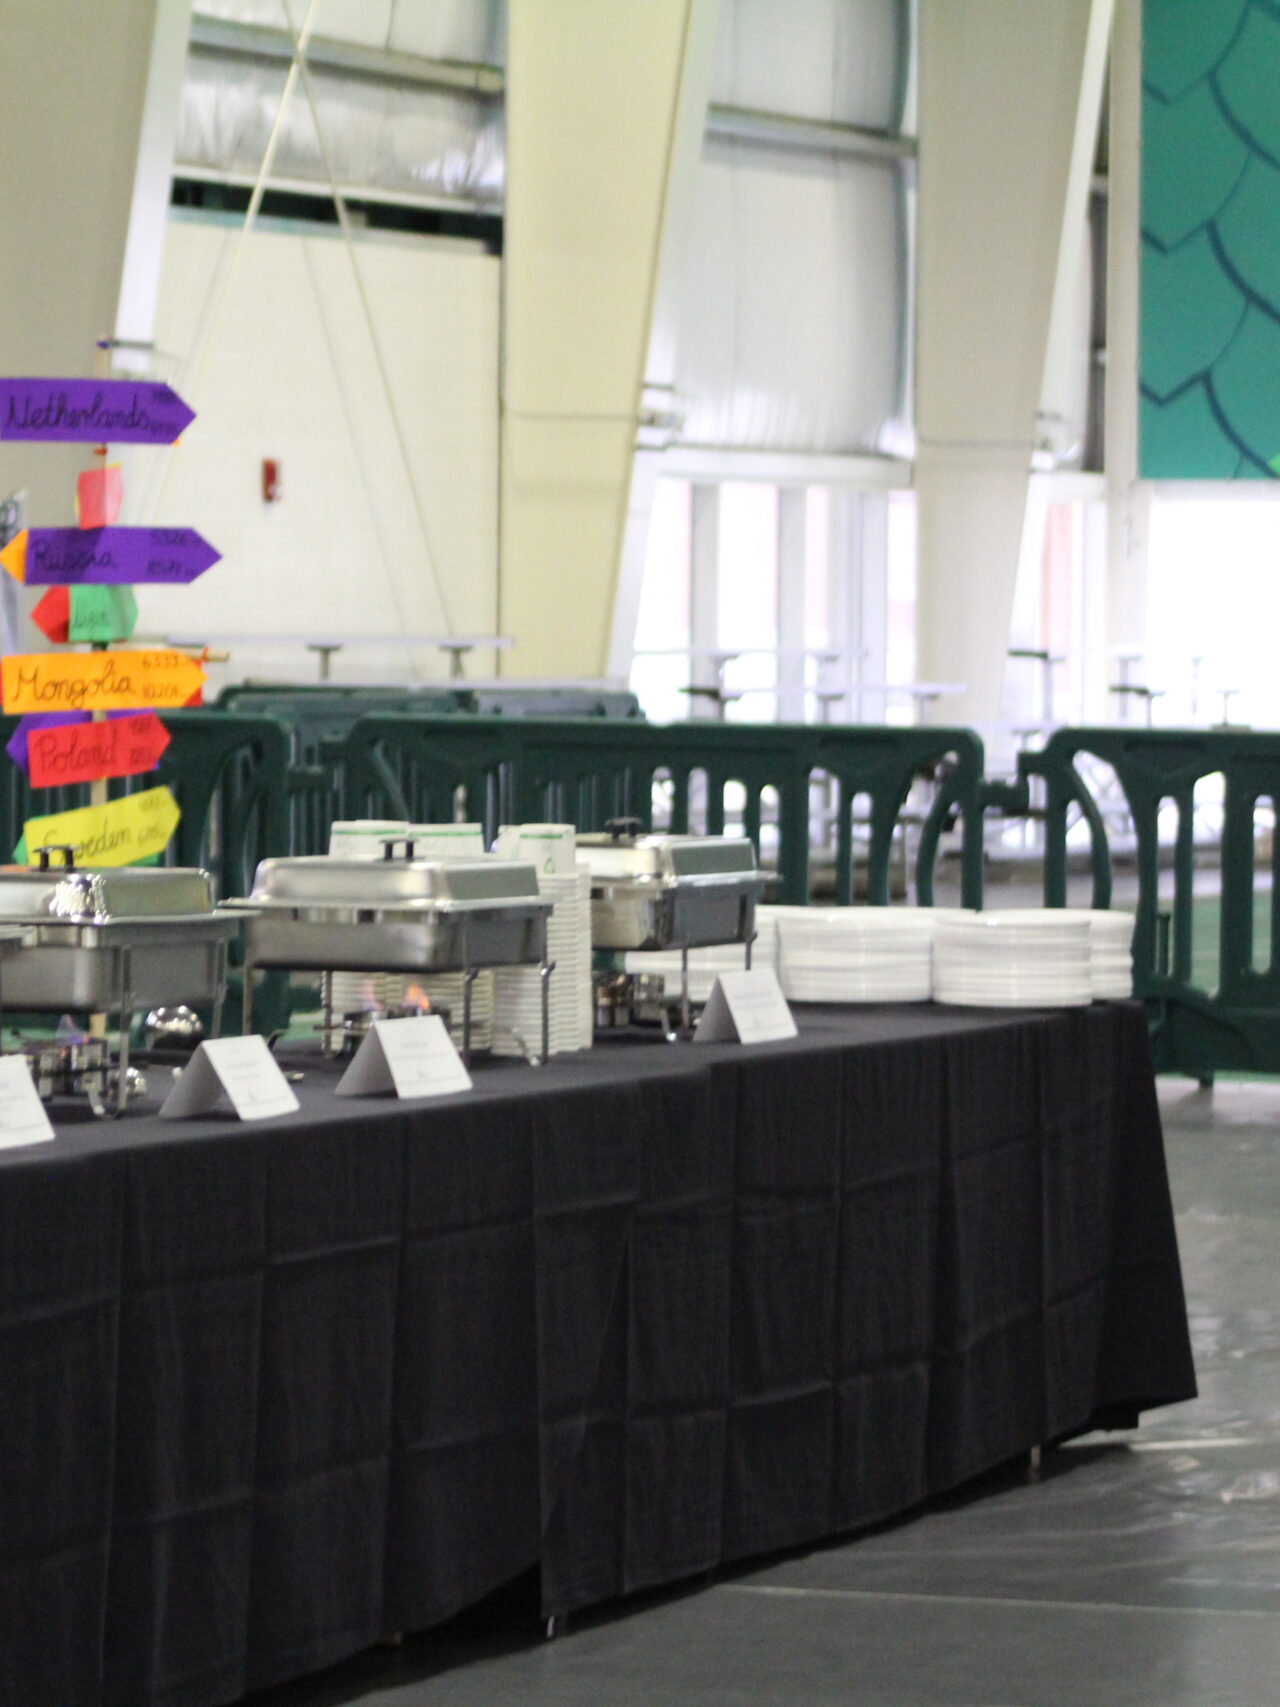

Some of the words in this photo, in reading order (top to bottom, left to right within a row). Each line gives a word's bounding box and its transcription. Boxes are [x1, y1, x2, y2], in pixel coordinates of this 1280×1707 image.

[6, 389, 150, 430] Netherlands
[11, 658, 137, 710] Mongolia
[33, 726, 119, 773] Poland
